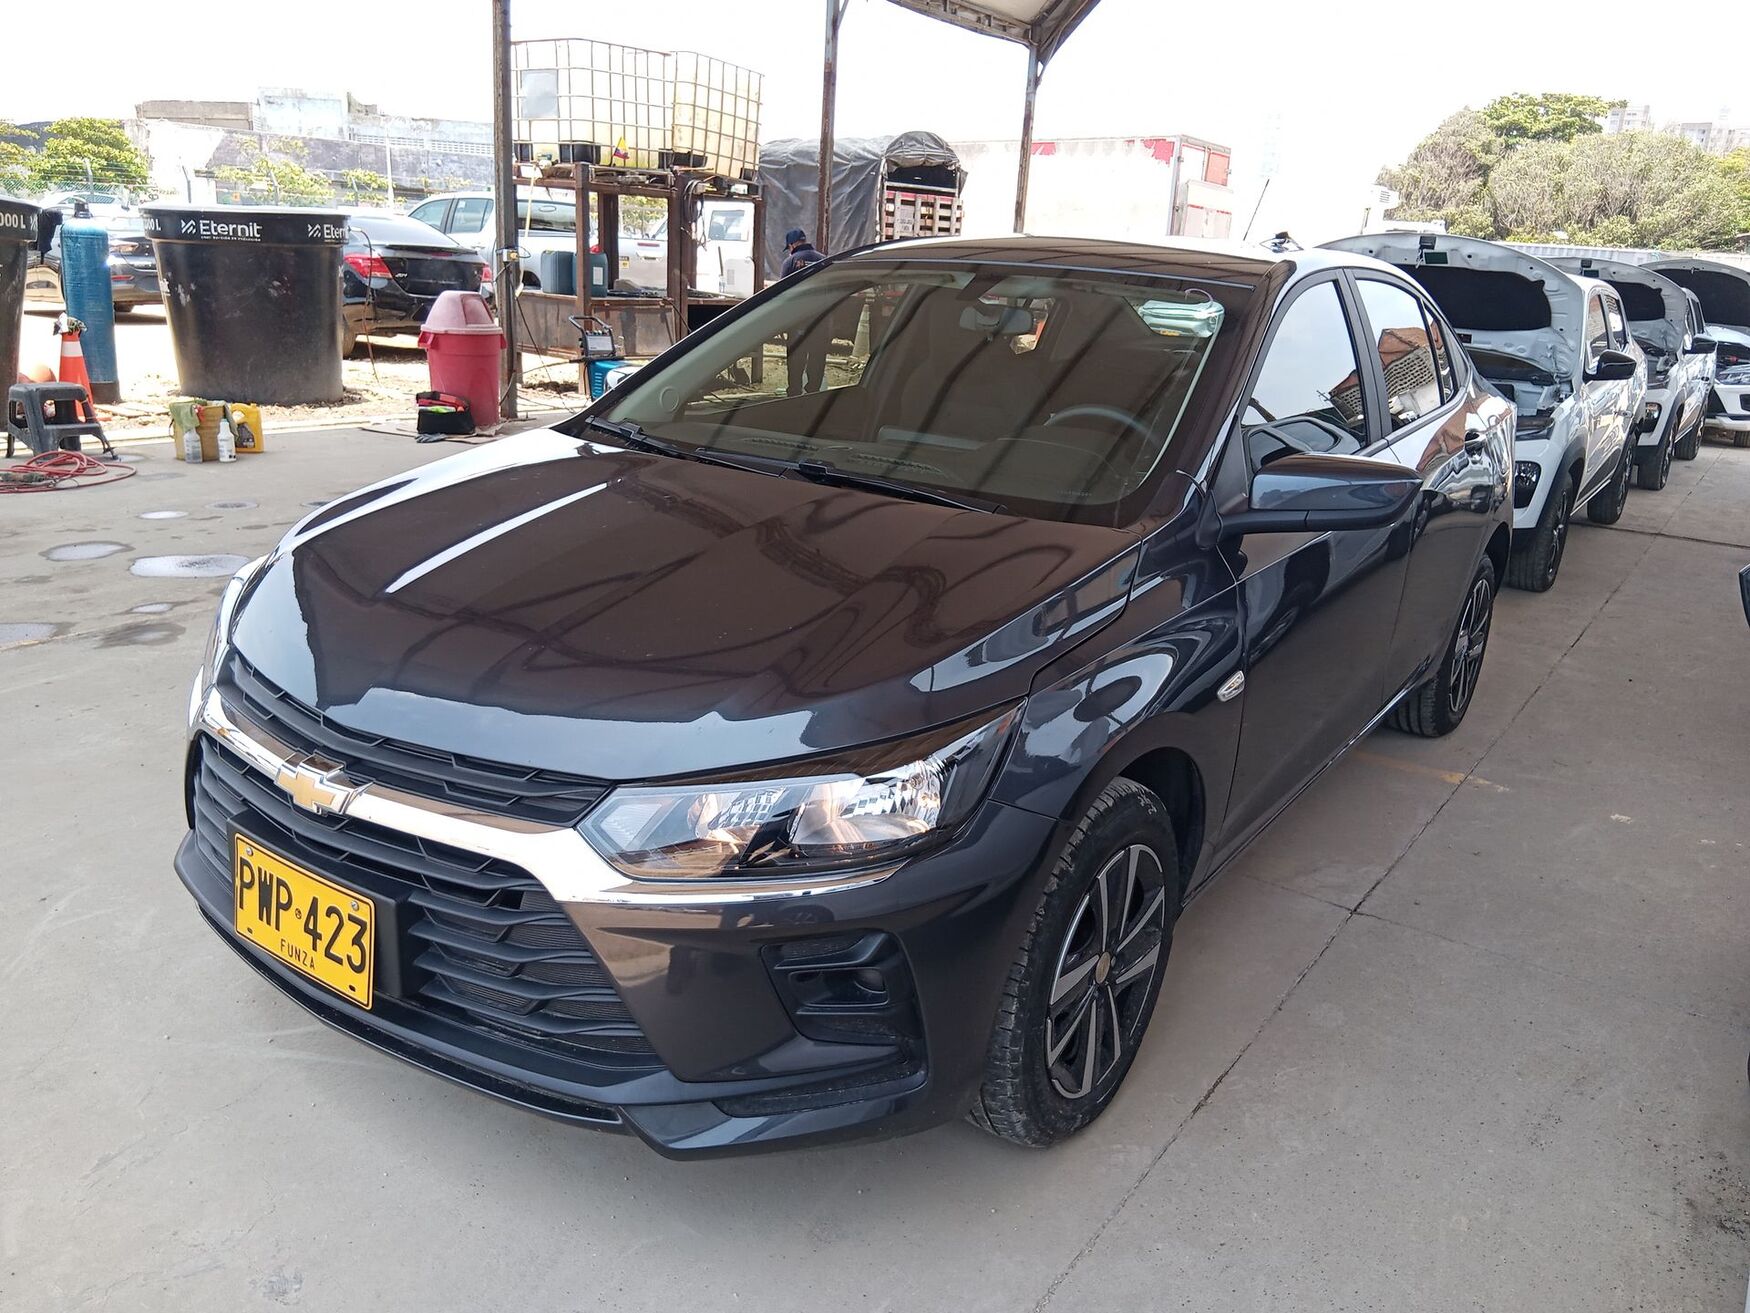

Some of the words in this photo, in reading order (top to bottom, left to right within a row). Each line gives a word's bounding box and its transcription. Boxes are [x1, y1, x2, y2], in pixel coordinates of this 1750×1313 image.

[200, 219, 263, 238] Eternit
[239, 856, 293, 931] PWP
[303, 895, 368, 974] 423
[280, 938, 316, 970] FUNZA
